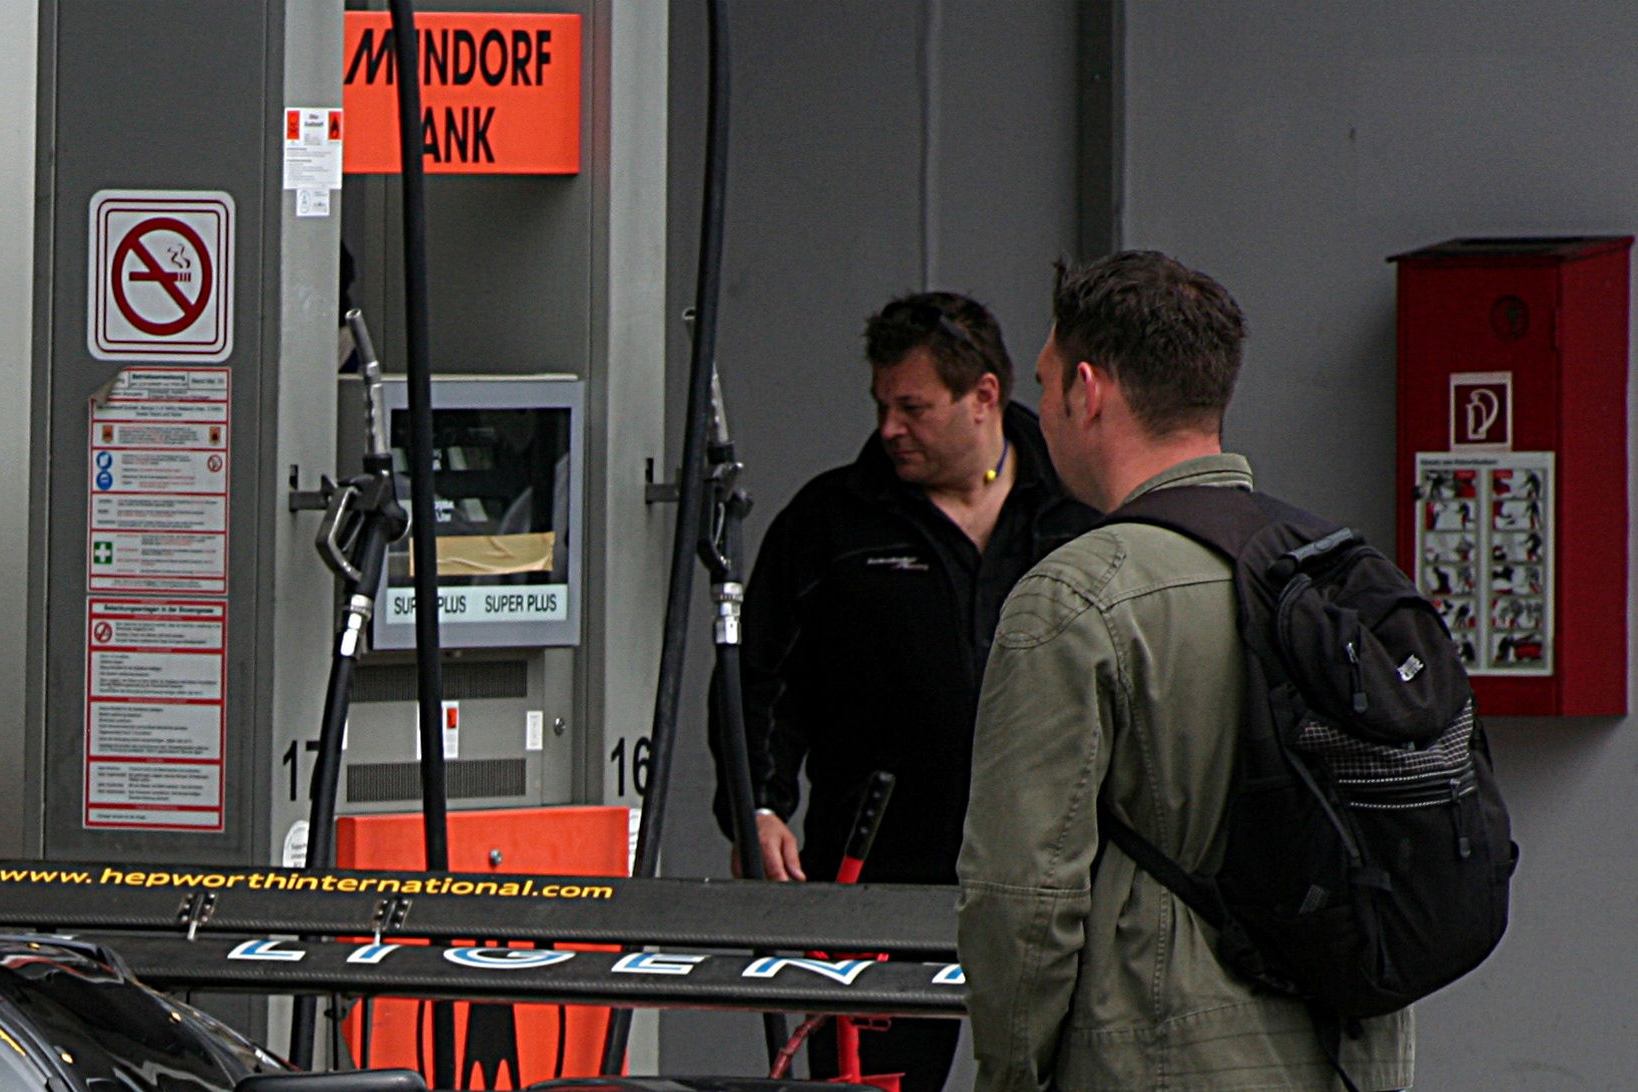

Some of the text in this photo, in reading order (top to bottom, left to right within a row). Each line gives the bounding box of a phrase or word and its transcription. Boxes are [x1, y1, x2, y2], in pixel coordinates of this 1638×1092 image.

[344, 28, 551, 86] MNDORF
[421, 106, 496, 163] ANK
[394, 596, 416, 615] SUP
[485, 593, 557, 613] SUPER PLUS
[611, 737, 653, 796] 16
[0, 868, 613, 898] www.hepworthinternational.com
